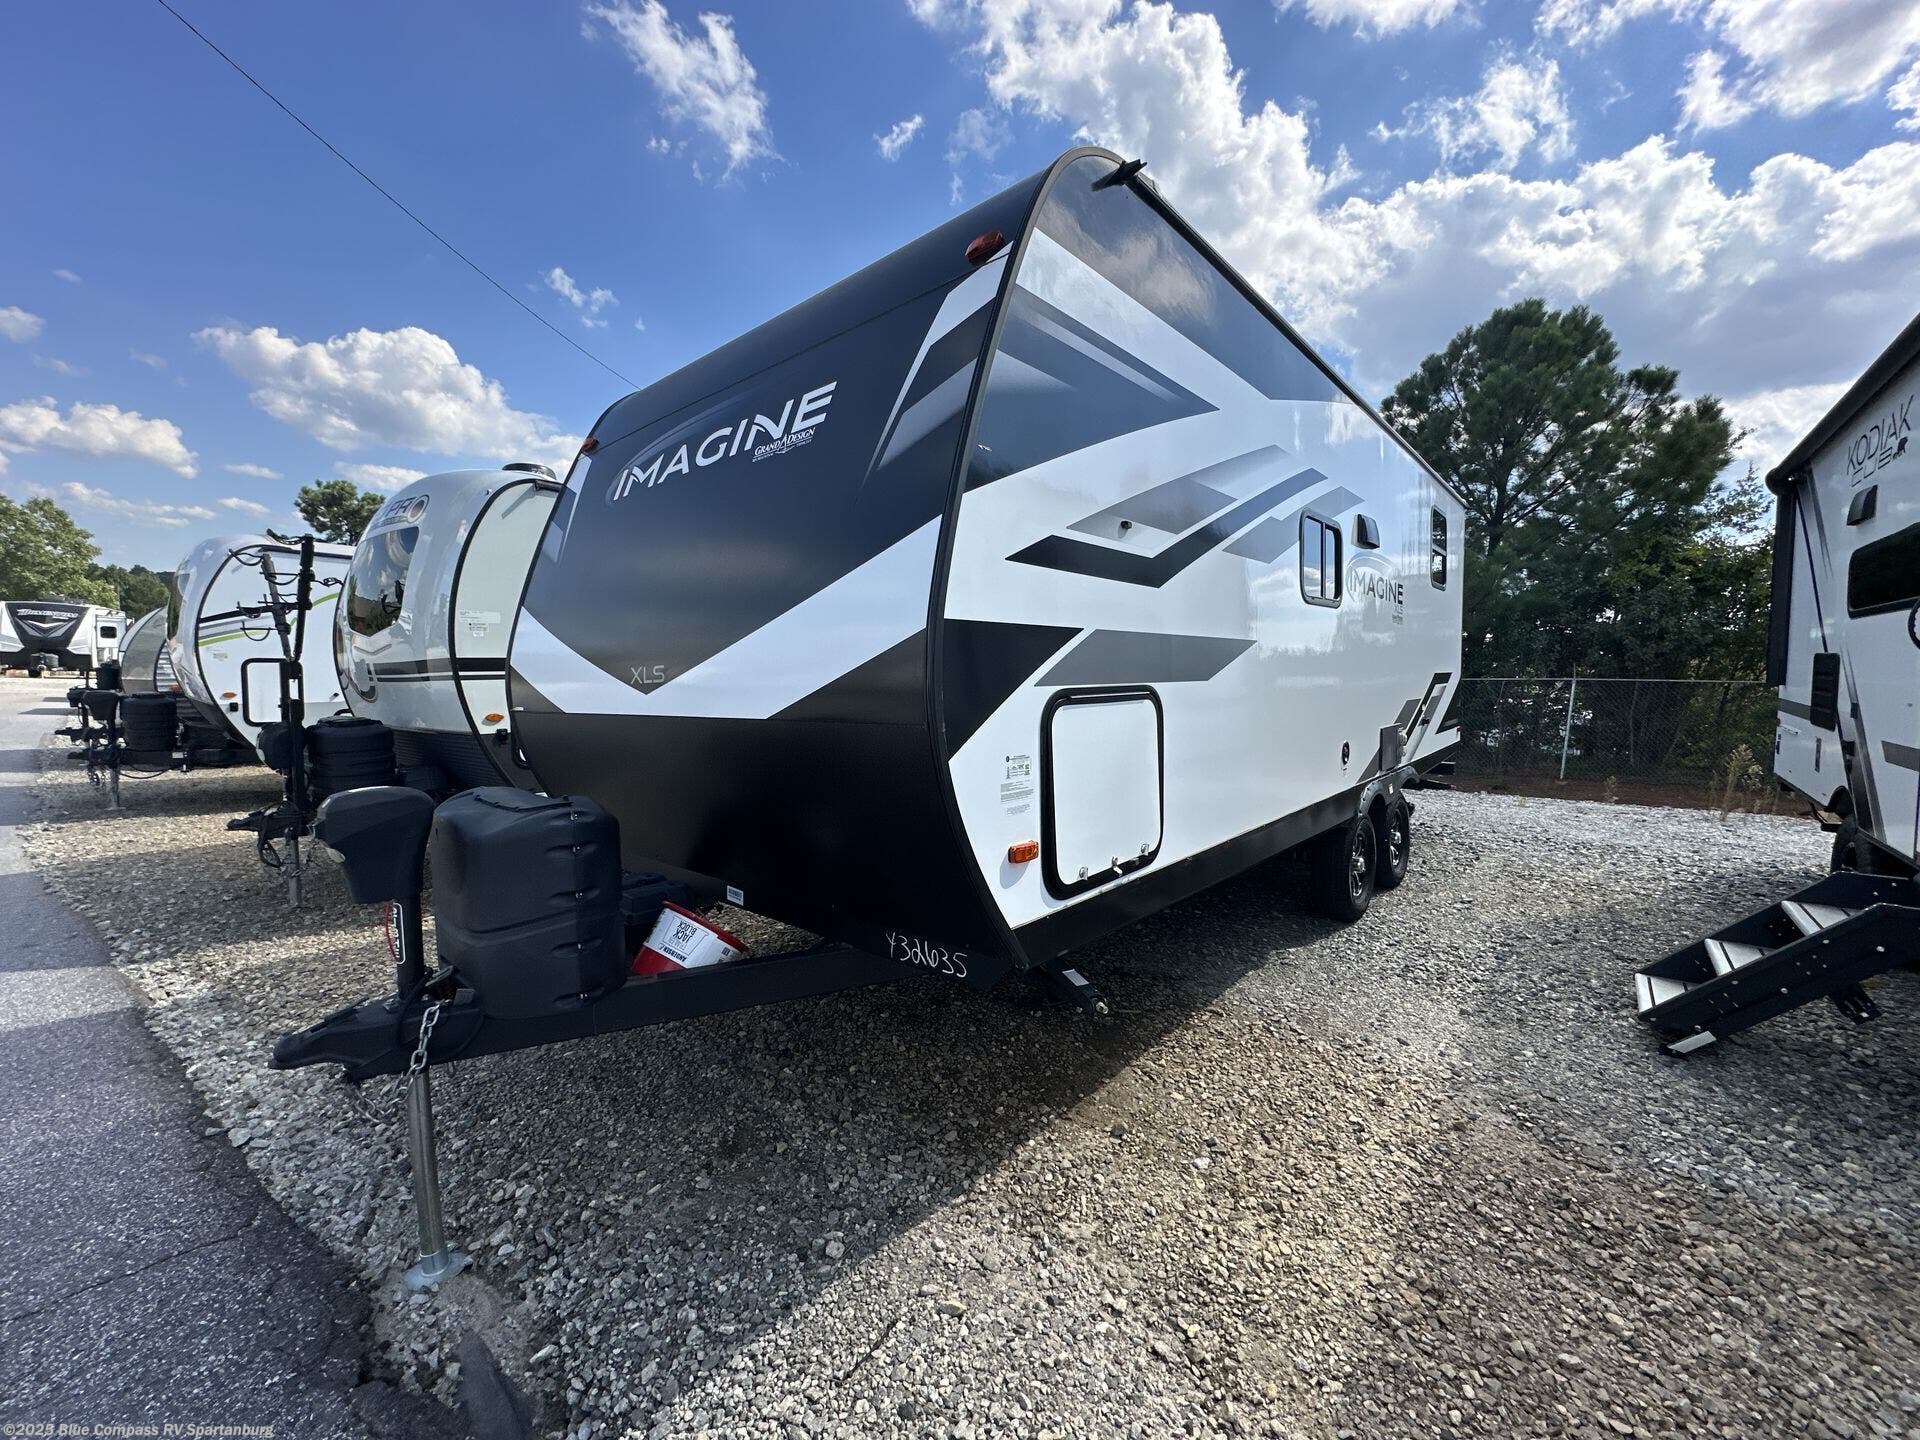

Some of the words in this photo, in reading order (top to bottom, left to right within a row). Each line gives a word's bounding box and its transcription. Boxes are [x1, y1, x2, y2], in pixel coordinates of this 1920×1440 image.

[613, 381, 838, 501] IMAGINE
[754, 440, 781, 456] GRAND
[787, 426, 816, 444] DESIGN
[1846, 394, 1914, 476] KODIAK
[1350, 566, 1404, 605] IMAGINE
[630, 664, 665, 685] XLS
[672, 928, 693, 944] JACK
[677, 920, 698, 936] BLOCK
